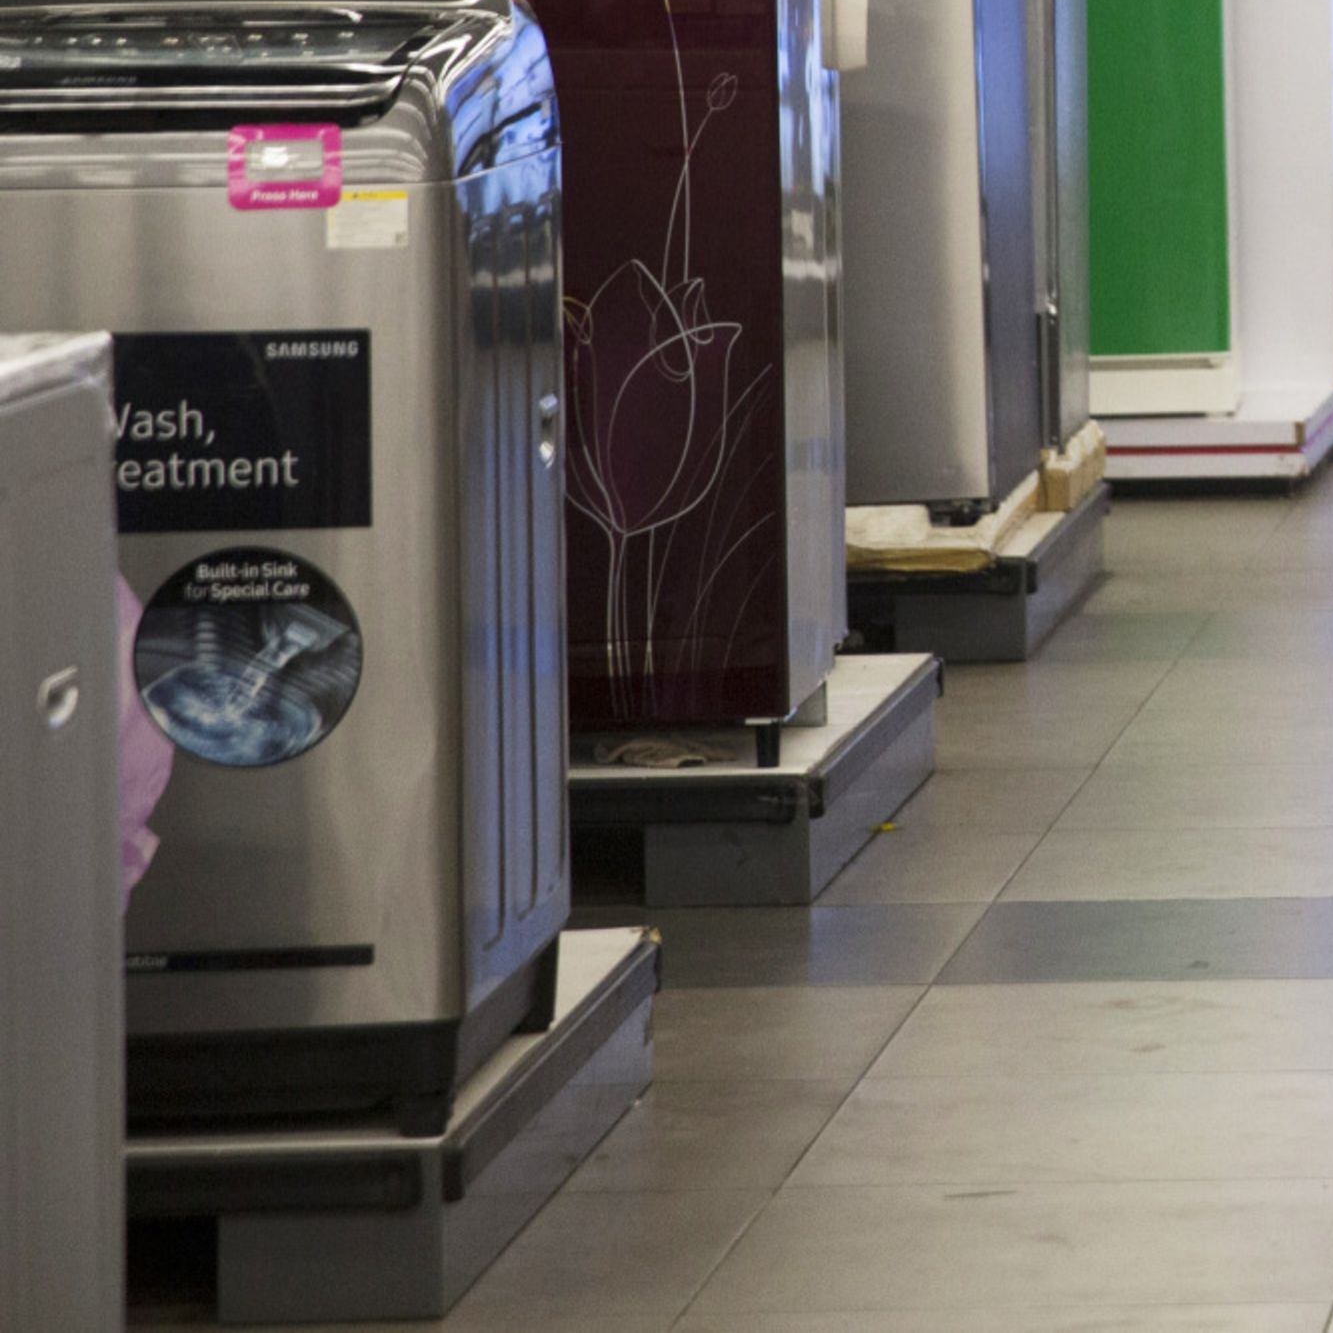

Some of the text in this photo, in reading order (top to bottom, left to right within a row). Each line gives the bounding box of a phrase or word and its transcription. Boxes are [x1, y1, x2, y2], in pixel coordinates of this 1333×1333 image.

[289, 191, 318, 200] Here
[265, 341, 359, 358] SAMSUNG
[116, 450, 299, 491] eatment
[197, 562, 298, 580] Built-in Sink
[186, 581, 310, 602] for Special Care
